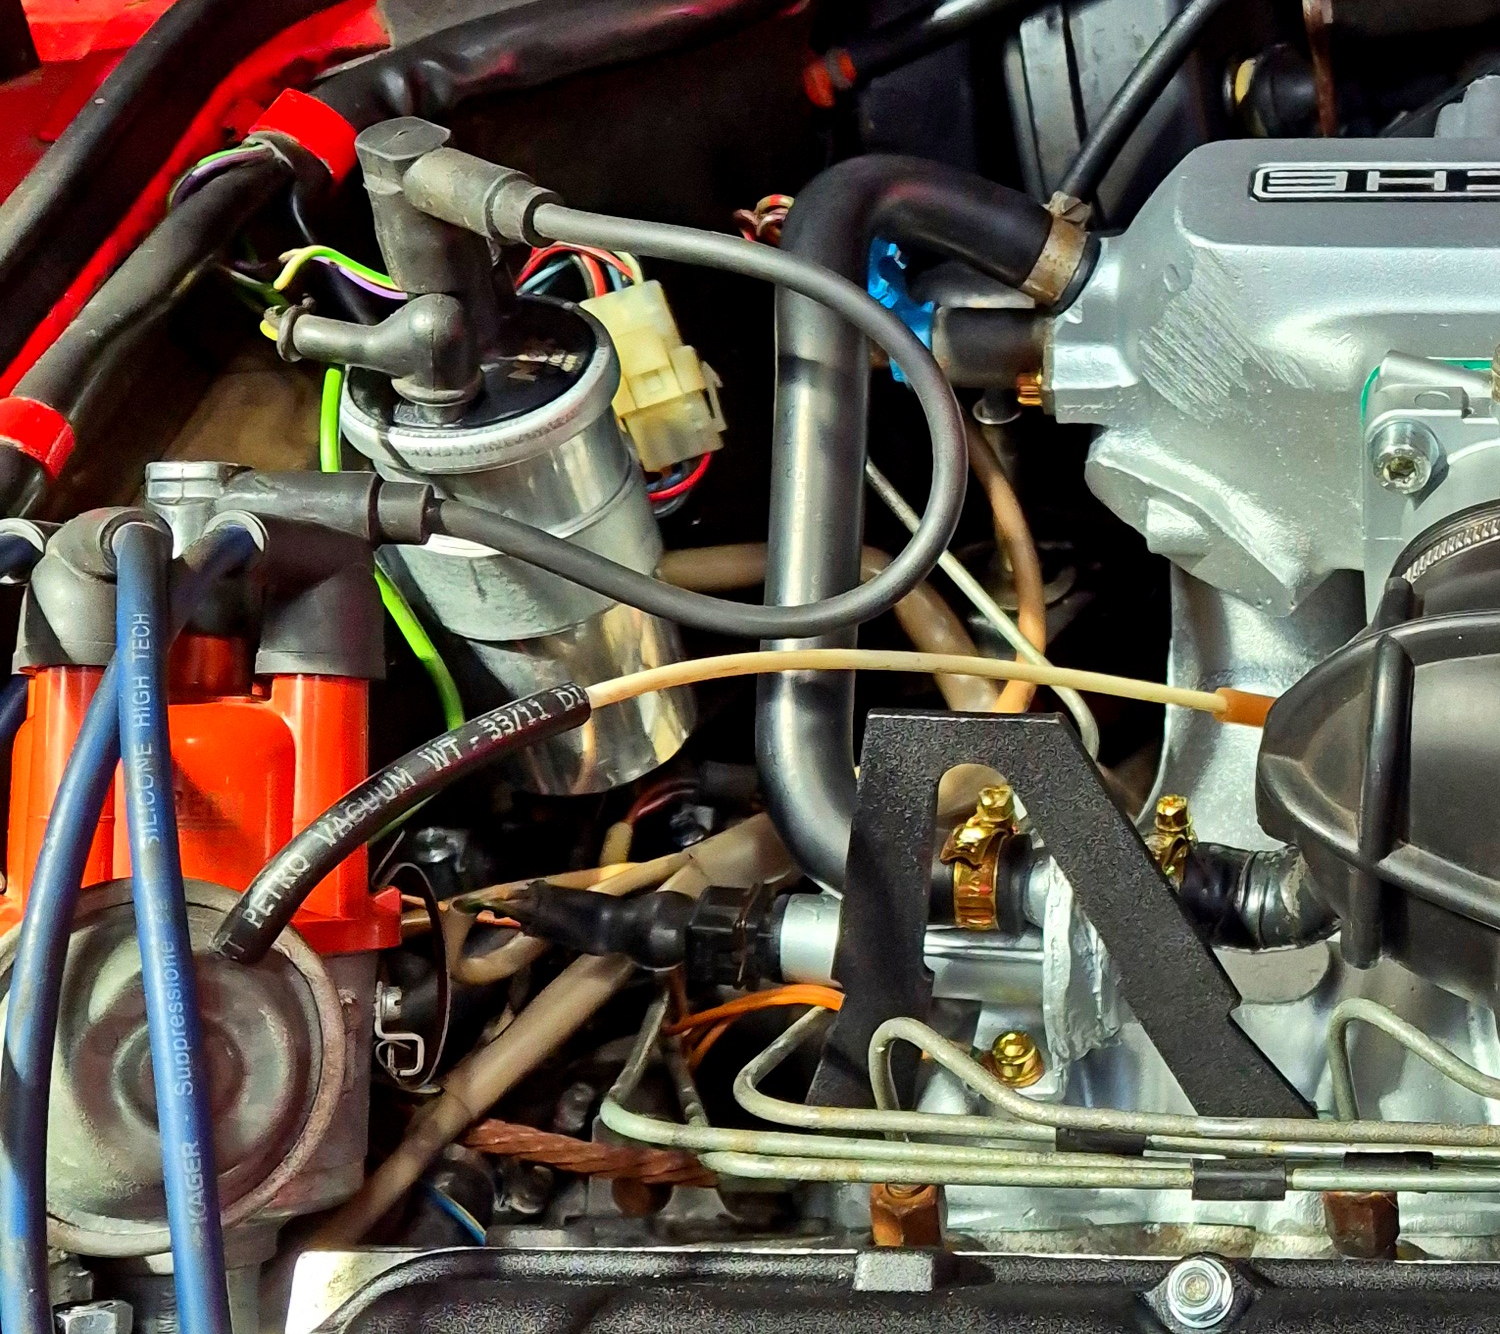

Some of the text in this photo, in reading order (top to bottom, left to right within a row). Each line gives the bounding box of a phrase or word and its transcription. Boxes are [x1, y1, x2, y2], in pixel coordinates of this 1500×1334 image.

[130, 613, 161, 847] SILICONE HIGH TECH
[309, 766, 416, 847] VACUUM
[418, 736, 466, 772] WT
